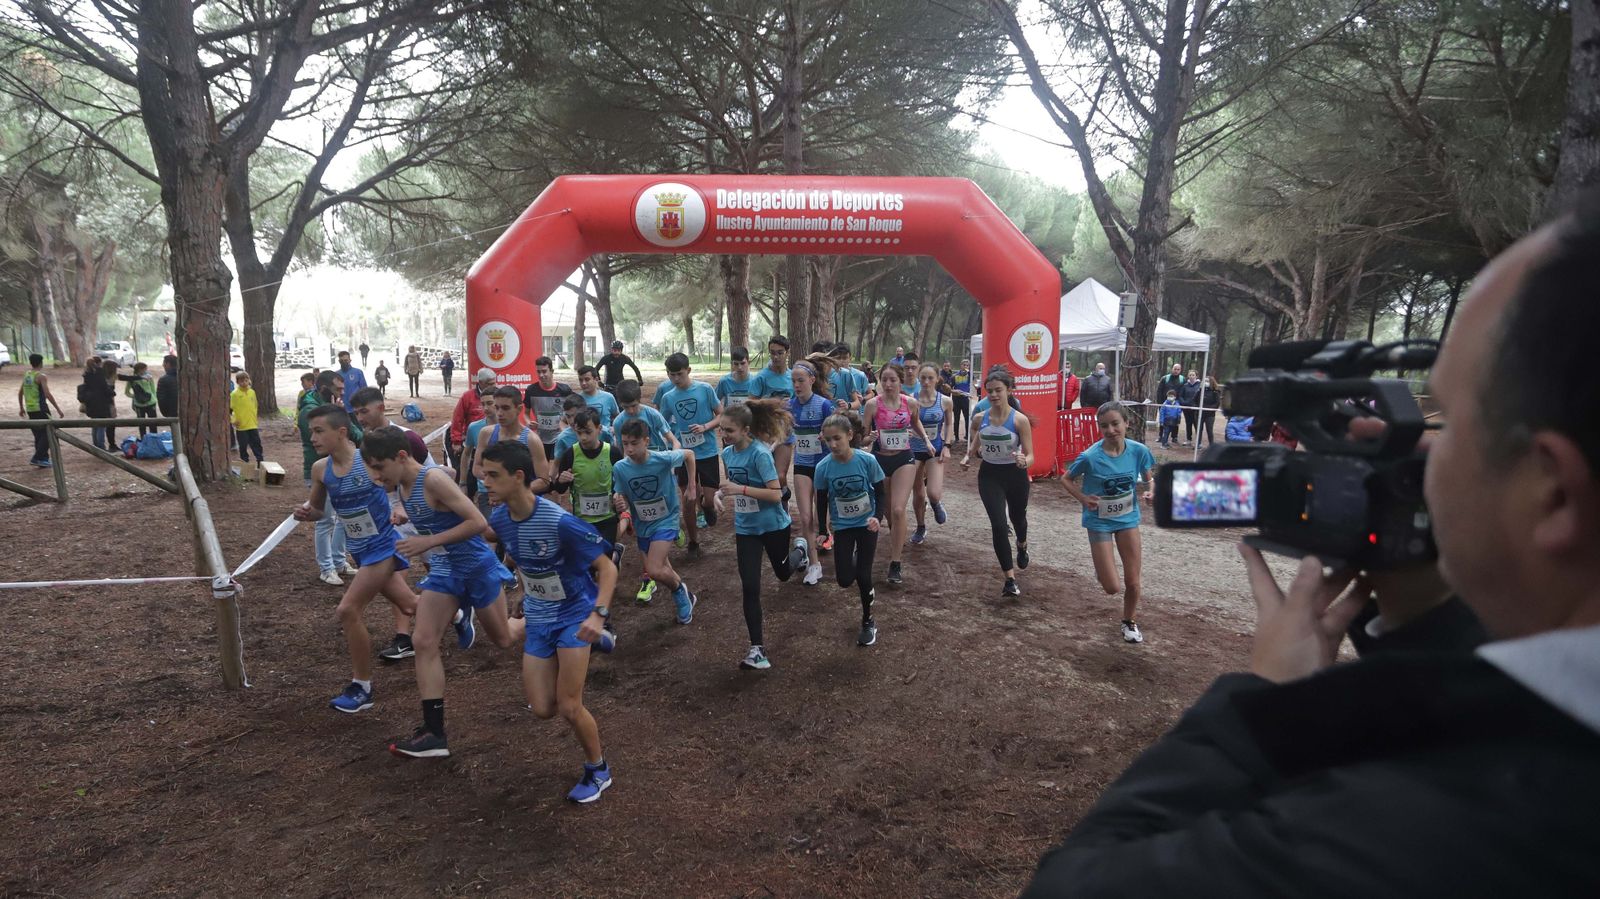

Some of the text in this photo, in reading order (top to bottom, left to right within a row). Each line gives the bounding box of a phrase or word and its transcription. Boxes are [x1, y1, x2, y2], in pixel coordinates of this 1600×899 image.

[716, 188, 904, 213] Delegación de Deportes
[716, 214, 903, 234] Ilustre Ayuntamiento de San Roque
[541, 418, 553, 426] 262
[886, 437, 900, 446] 613
[984, 444, 1001, 453] 261
[586, 501, 600, 511] 547
[844, 504, 860, 514] 535
[1107, 503, 1124, 514] 539
[642, 508, 657, 518] 532
